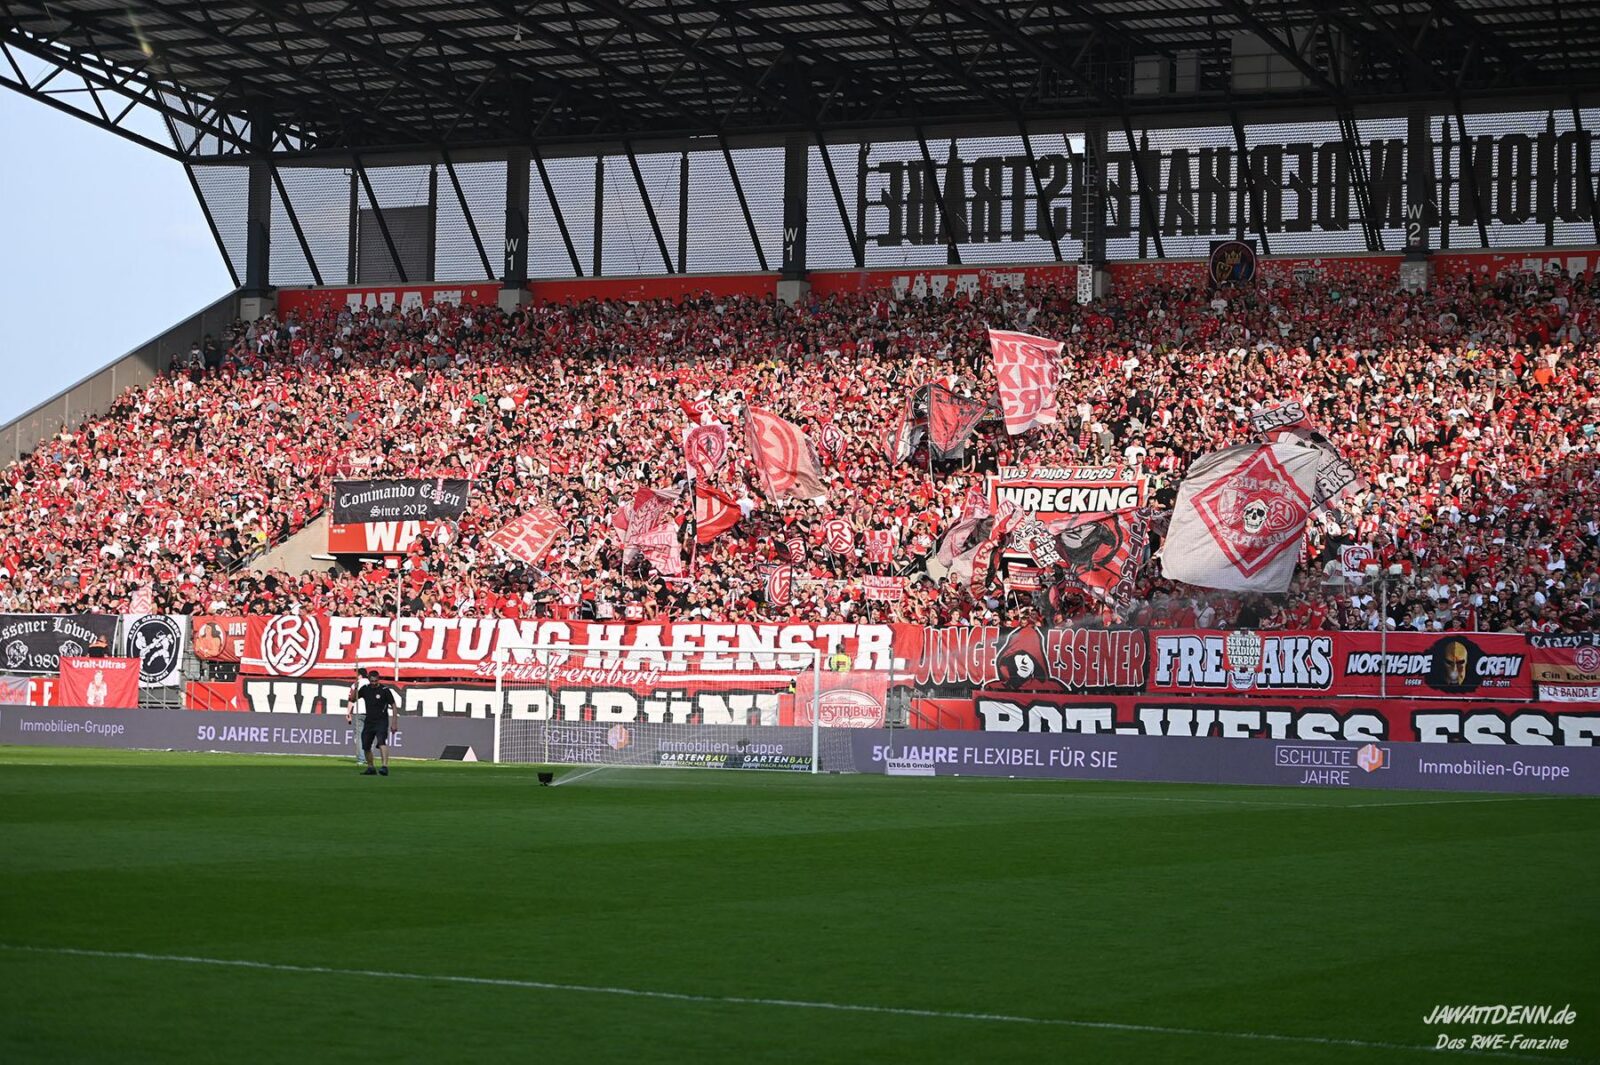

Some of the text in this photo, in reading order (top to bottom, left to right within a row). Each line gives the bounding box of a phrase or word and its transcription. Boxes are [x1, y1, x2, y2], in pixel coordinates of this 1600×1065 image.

[1407, 204, 1423, 219] W
[784, 227, 798, 242] W
[1409, 223, 1421, 241] 2
[505, 238, 519, 252] W
[786, 245, 793, 261] 1
[508, 255, 514, 271] 1
[1074, 467, 1117, 481] LOCOS
[339, 482, 460, 508] Commando Essen
[997, 486, 1139, 513] WRECKING
[370, 504, 428, 517] Since 2012
[0, 617, 98, 644] ssener Löwen
[228, 623, 247, 636] HAF
[325, 616, 906, 672] FESTUNG HAFENSTR.
[1226, 646, 1262, 656] STADION
[28, 653, 60, 669] 1980
[72, 659, 127, 669] Uralt-Ultras
[914, 626, 1147, 688] JUNGE ESSENER
[1228, 656, 1260, 666] VERBOT
[1346, 653, 1524, 678] NORTHSIDE CREW
[1560, 687, 1590, 699] BANDA
[20, 719, 125, 736] Immobilien-Gruppe
[197, 725, 216, 741] 50
[218, 726, 269, 743] JAHRE
[273, 728, 341, 745] FLEXIBEL
[543, 729, 602, 744] SCHULTE
[560, 748, 601, 762] JAHRE
[661, 752, 728, 762] GARTENBAU
[743, 754, 812, 765] GARTENBAU
[897, 745, 959, 763] JAHRE
[963, 748, 1044, 766] FLEXIBEL
[1050, 746, 1085, 768] FÜR
[1090, 750, 1118, 768] SIE
[1279, 749, 1350, 765] SCHULTE
[1419, 758, 1570, 780] Immobilien-Gruppe
[1300, 770, 1350, 785] JAHRE
